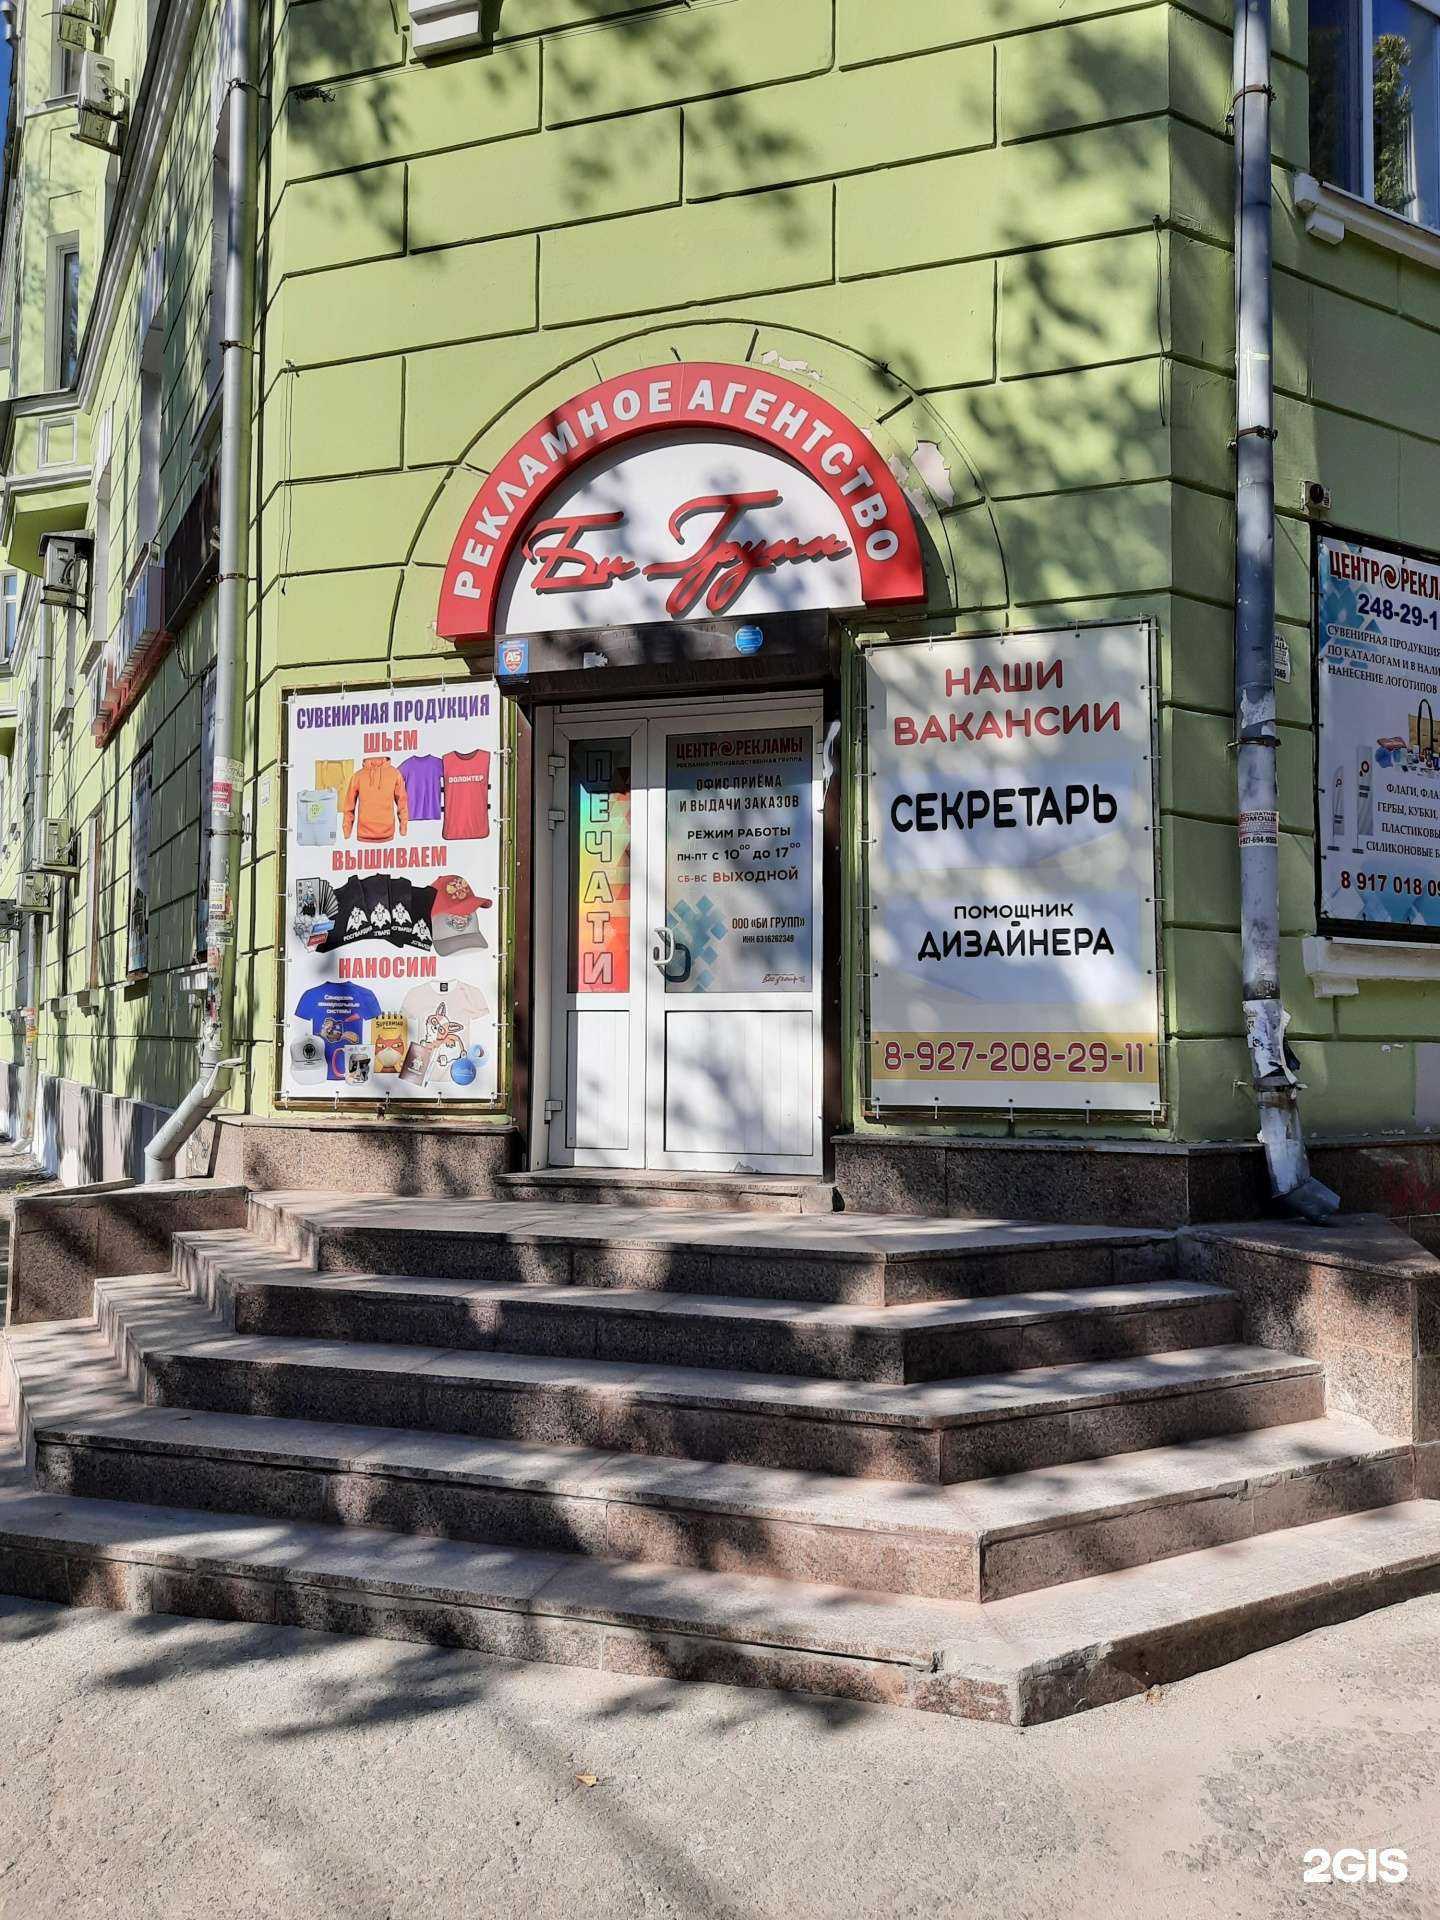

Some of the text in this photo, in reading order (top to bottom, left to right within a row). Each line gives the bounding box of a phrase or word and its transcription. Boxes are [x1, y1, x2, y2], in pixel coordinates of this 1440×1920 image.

[452, 378, 900, 600] РЕКЛАМНОЕ АГЕНТСТВО
[1329, 551, 1440, 600] ЦЕНТР РЕКЛ
[1358, 593, 1438, 631] 248-29-1
[1327, 624, 1388, 645] СУВЕНИРНАЯ
[1328, 645, 1342, 657] ПО
[1344, 648, 1400, 669] КАТАЛОГАМ
[1403, 659, 1409, 669] И
[1410, 661, 1416, 672] В
[945, 659, 1063, 697] НАШИ
[1328, 665, 1438, 694] НАНЕСЕНИЕ ЛОГОТИПОВ
[296, 694, 491, 730] СУВЕНИРНАЯ ПРОДУКЦИЯ
[894, 701, 1121, 746] ВАКАНСИИ
[363, 729, 418, 753] ШЬЕМ
[676, 737, 803, 760] ЦЕНТР РЕКЛАМЫ
[696, 775, 782, 791] ОФИС ПРИЁМА
[1386, 783, 1440, 801] ФЛАГИ, ФЛА
[679, 796, 799, 813] И ВЫДАЧИ ЗАКАЗОВ
[890, 783, 1118, 833] СЕКРЕТАРЬ
[1377, 802, 1439, 820] ГЕРБЫ, КУБКИ,
[687, 827, 790, 839] РЕЖИМ РАБОТЫ
[332, 846, 447, 871] ВЫШИВАЕМ
[1366, 841, 1433, 858] СИЛИКОНОВЫЕ
[583, 750, 614, 985] ПЕЧАТИ
[713, 867, 798, 883] ВЫХОДНОЙ
[1340, 870, 1351, 889] 8
[1357, 872, 1387, 892] 917
[1393, 877, 1422, 896] 018
[732, 916, 805, 929] ООО «БИ ГРУПП»
[953, 903, 1074, 920] ПОМОЩНИК
[742, 935, 755, 944] ИНН
[917, 920, 1115, 962] ДИЗАЙНЕРА
[338, 955, 437, 979] НАНОСИМ
[883, 1040, 1144, 1075] 8-927-208-29-11
